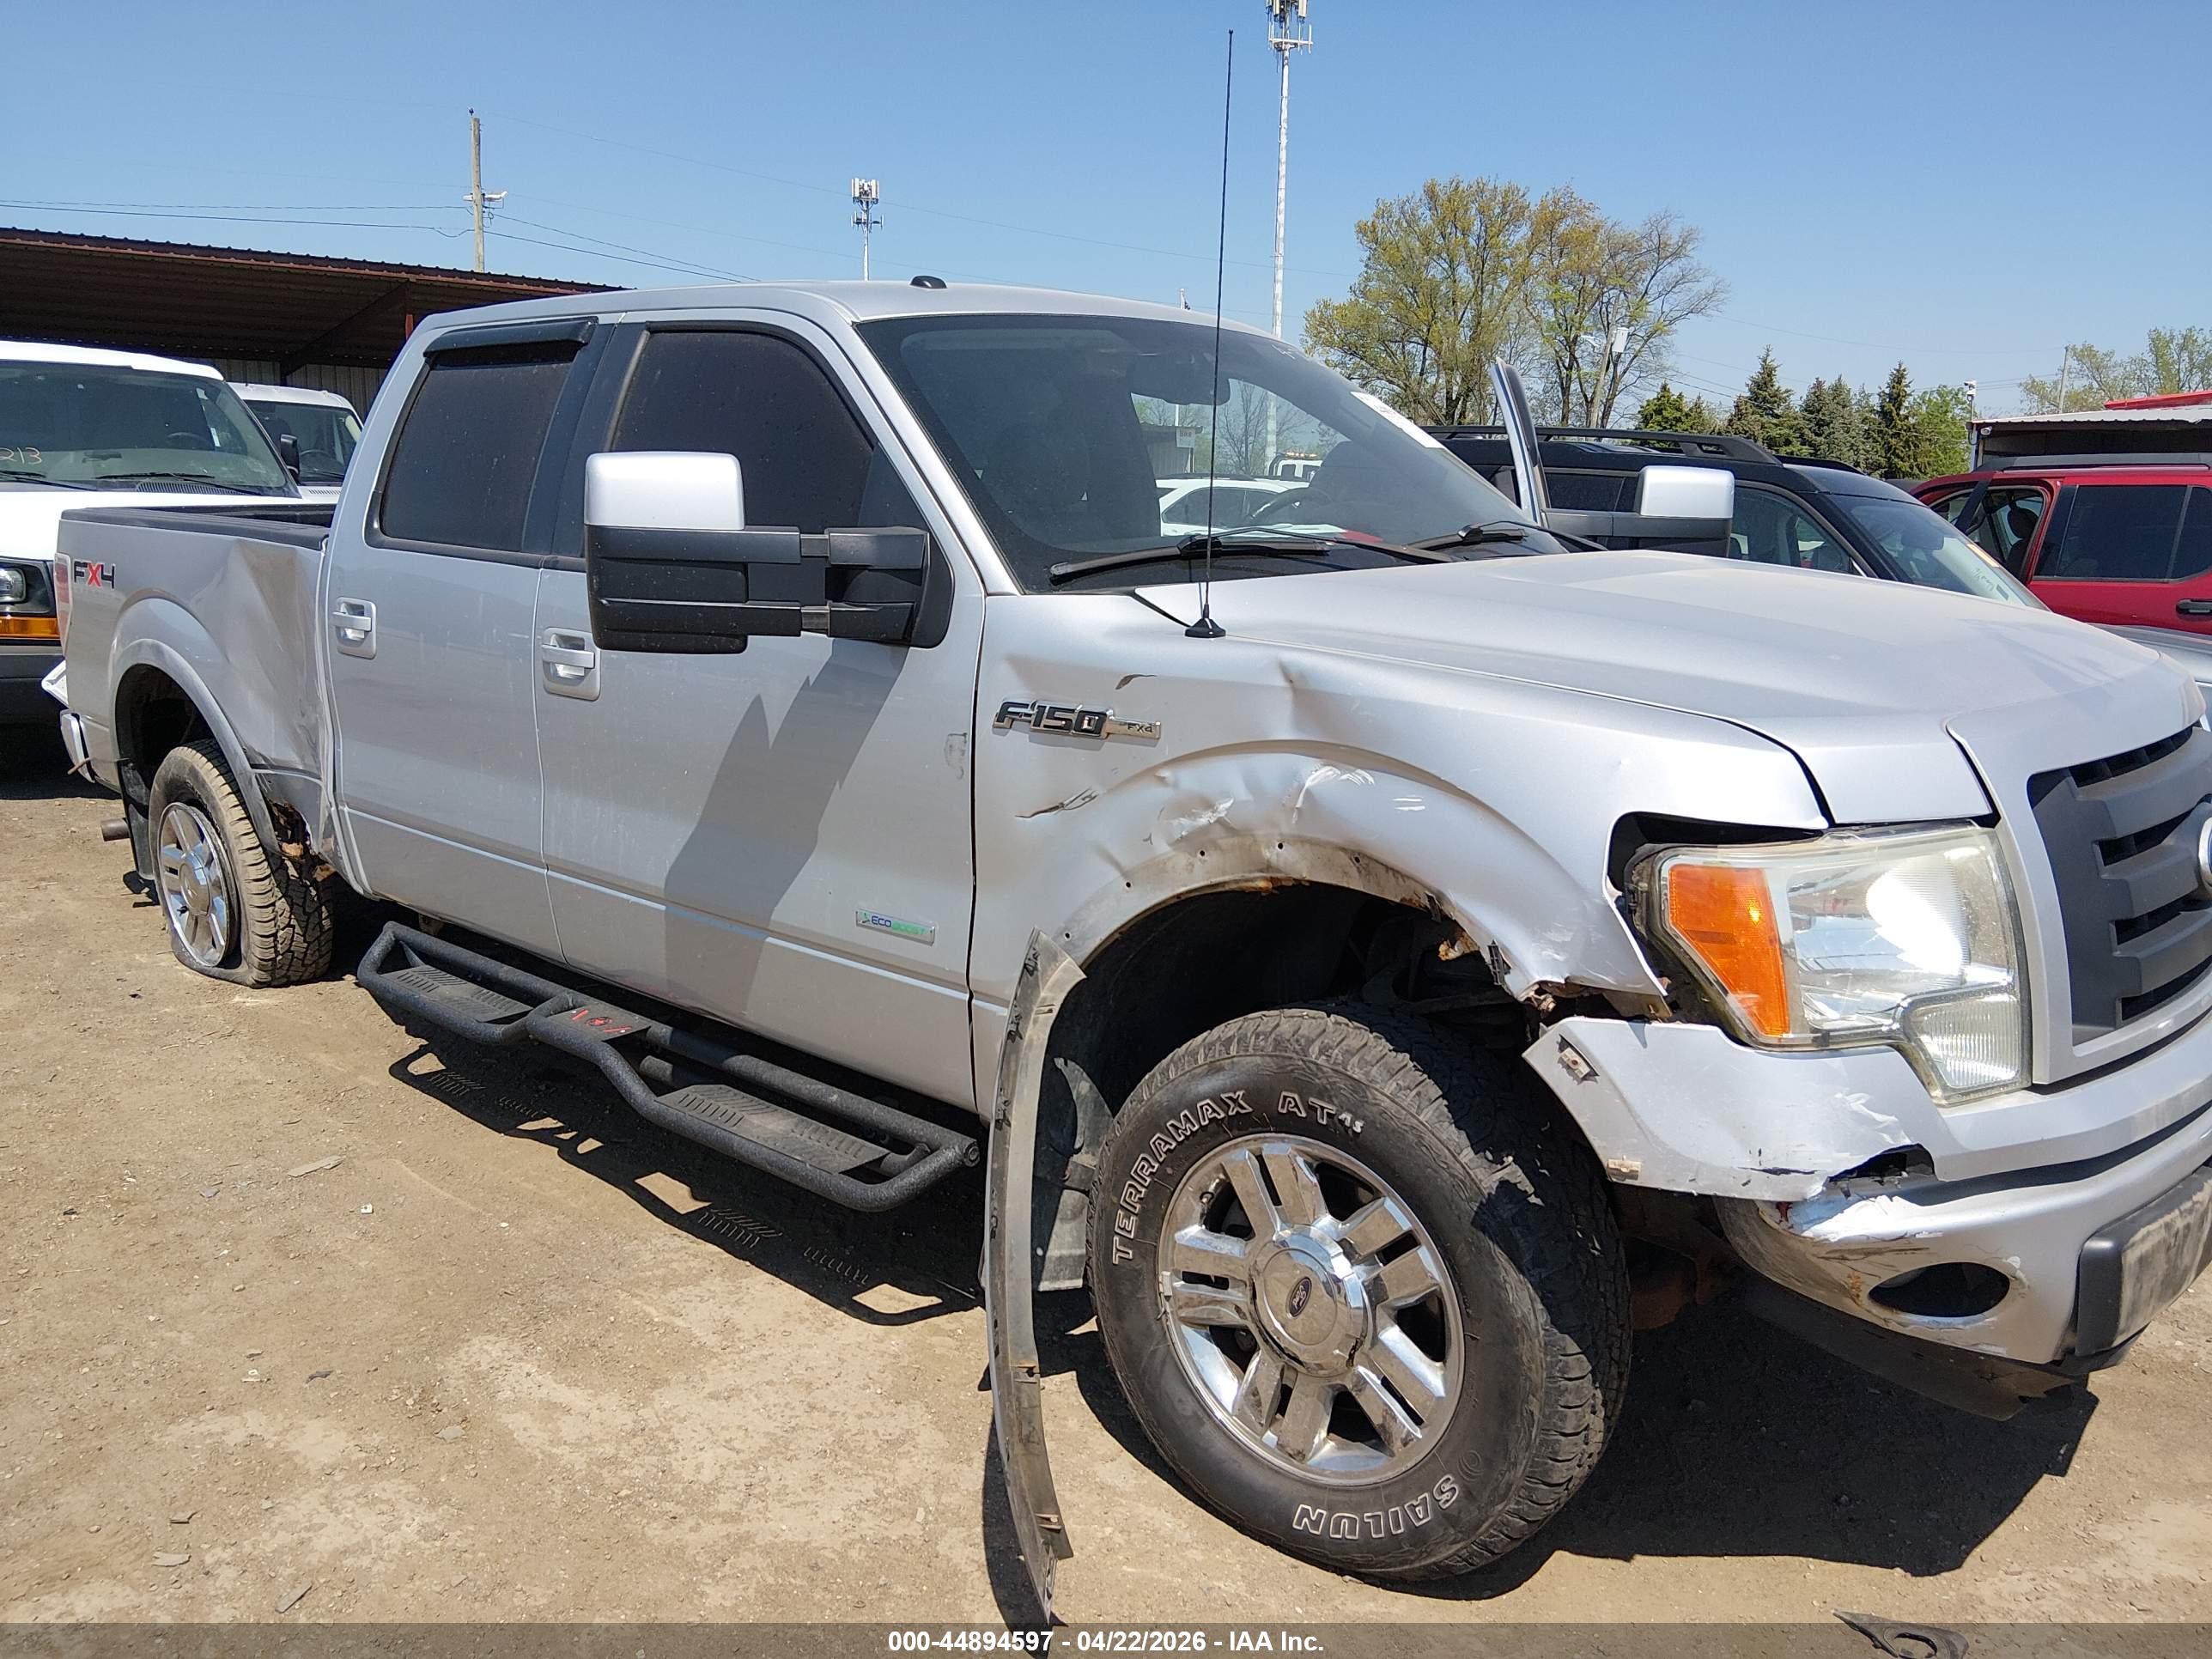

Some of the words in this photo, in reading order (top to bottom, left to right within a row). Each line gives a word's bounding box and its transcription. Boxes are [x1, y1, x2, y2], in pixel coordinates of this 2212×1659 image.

[73, 559, 116, 591] FX4
[1127, 722, 1153, 734] FX4
[1113, 1091, 1254, 1265] TERRAMAX
[1292, 1474, 1459, 1540] SAILUN
